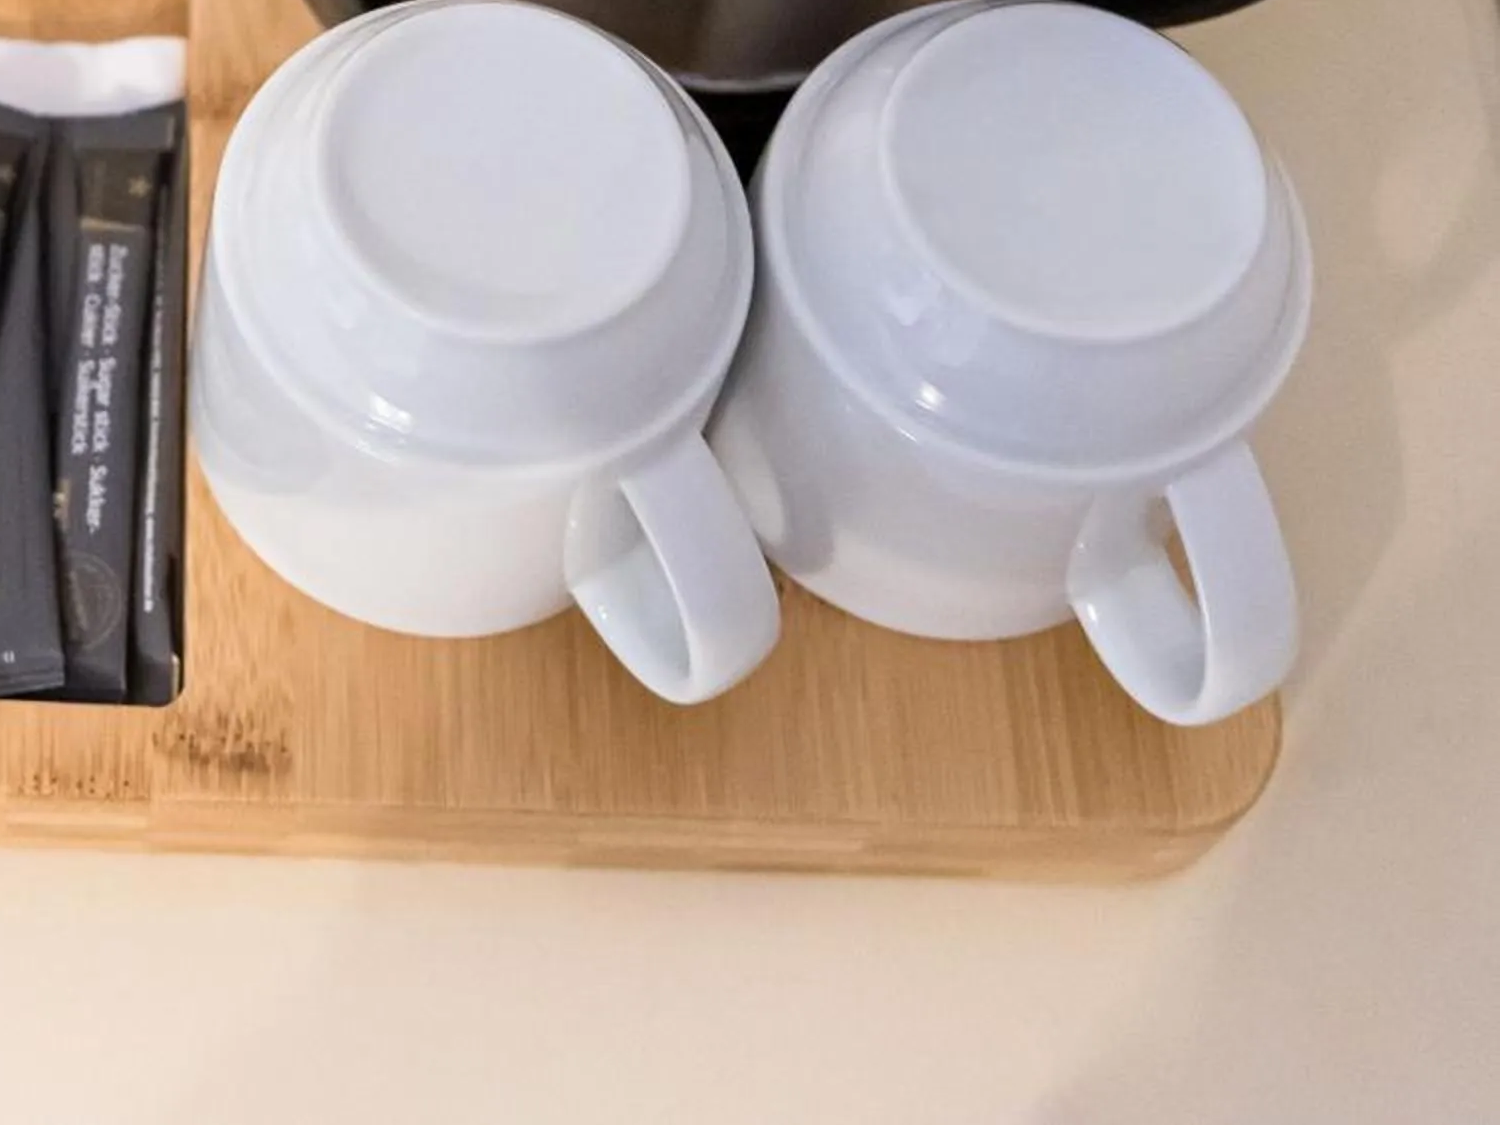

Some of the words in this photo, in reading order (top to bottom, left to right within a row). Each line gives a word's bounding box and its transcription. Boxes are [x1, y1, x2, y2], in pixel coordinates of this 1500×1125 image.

[87, 244, 106, 282] stick
[92, 357, 118, 406] Sugar
[92, 411, 111, 453] stick
